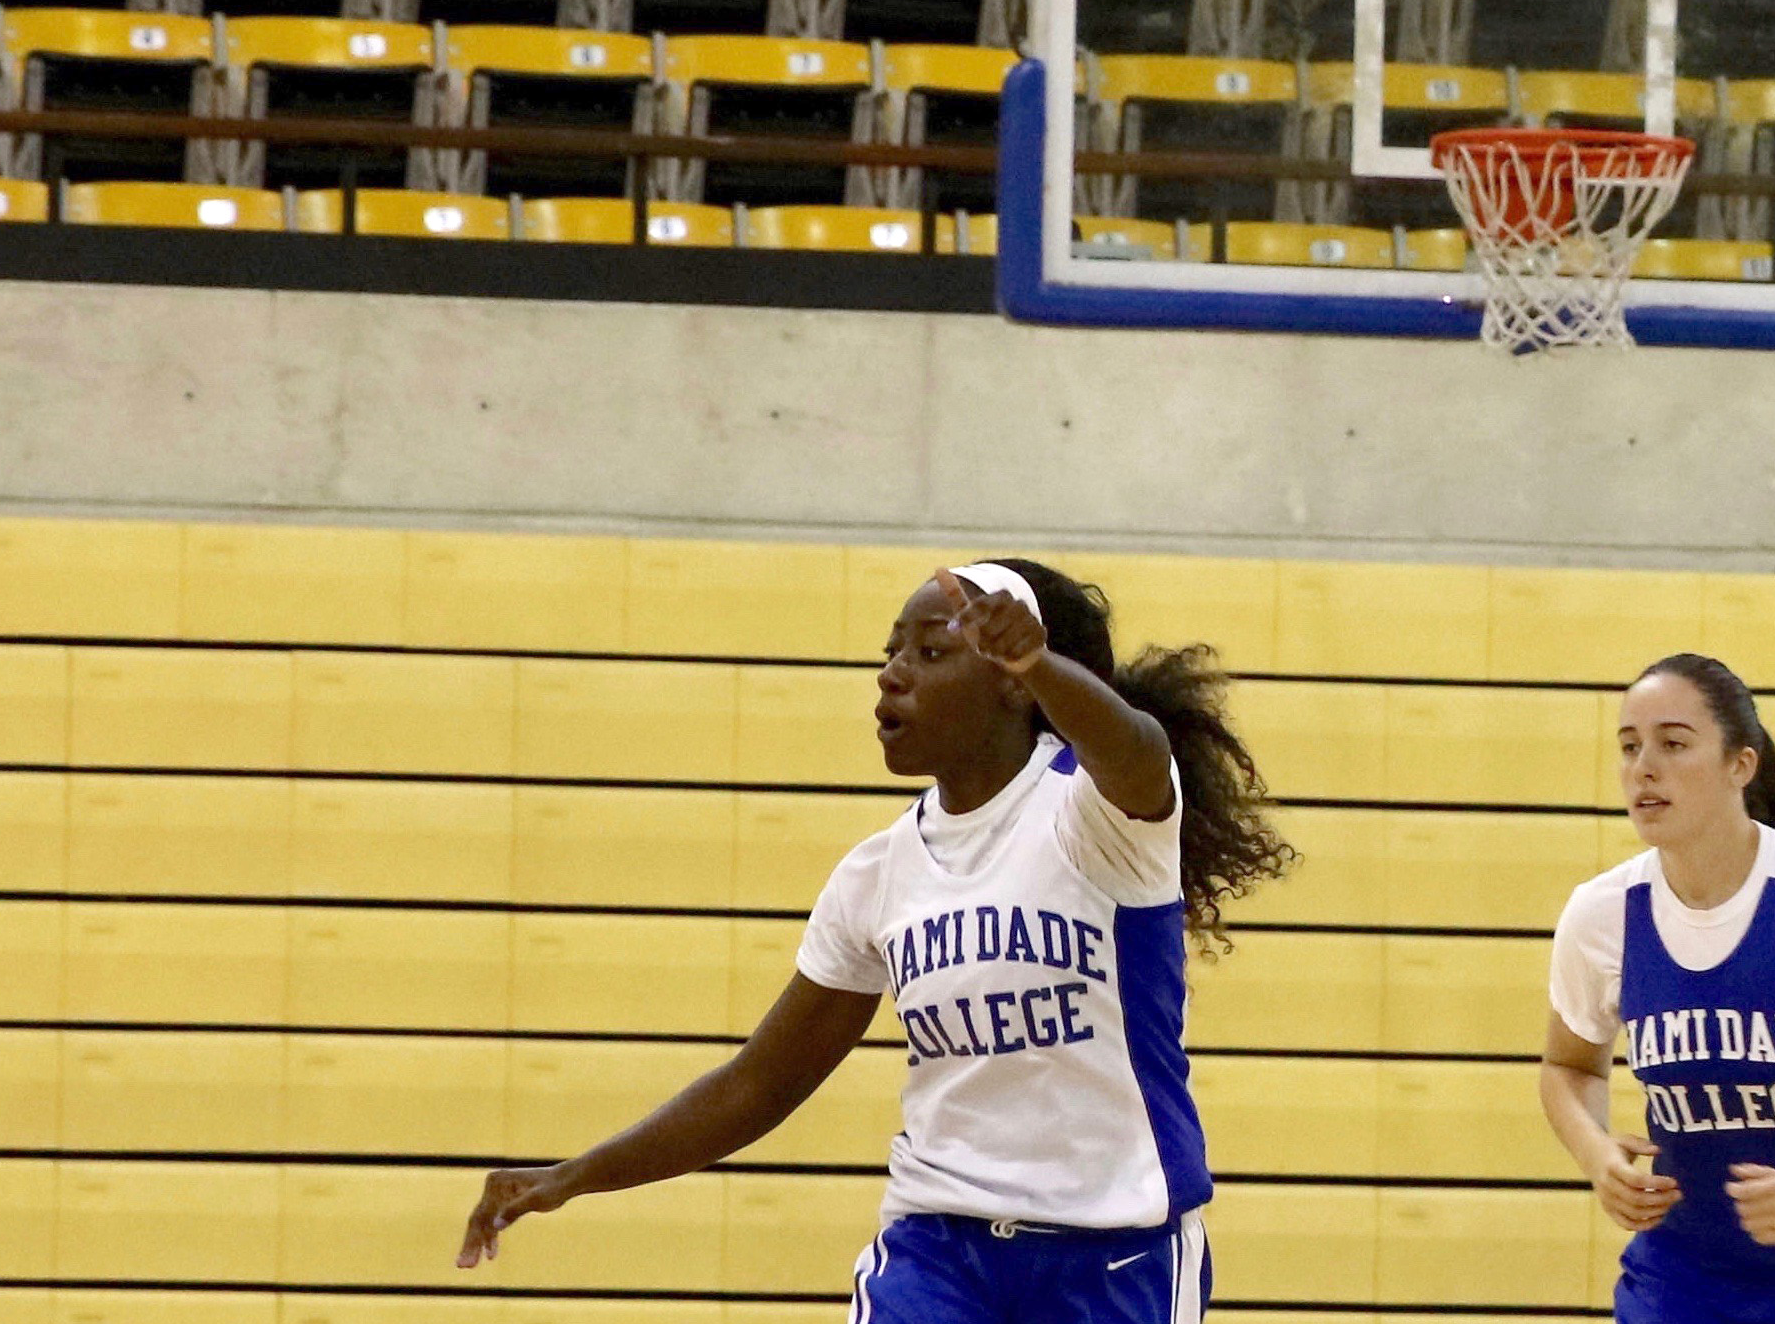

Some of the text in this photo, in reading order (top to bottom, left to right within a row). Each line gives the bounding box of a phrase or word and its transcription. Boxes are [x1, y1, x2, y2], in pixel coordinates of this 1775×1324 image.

[883, 905, 1107, 1002] IAMI DADE
[898, 982, 1094, 1067] OLLEGE
[1626, 1008, 1712, 1071] IAMI
